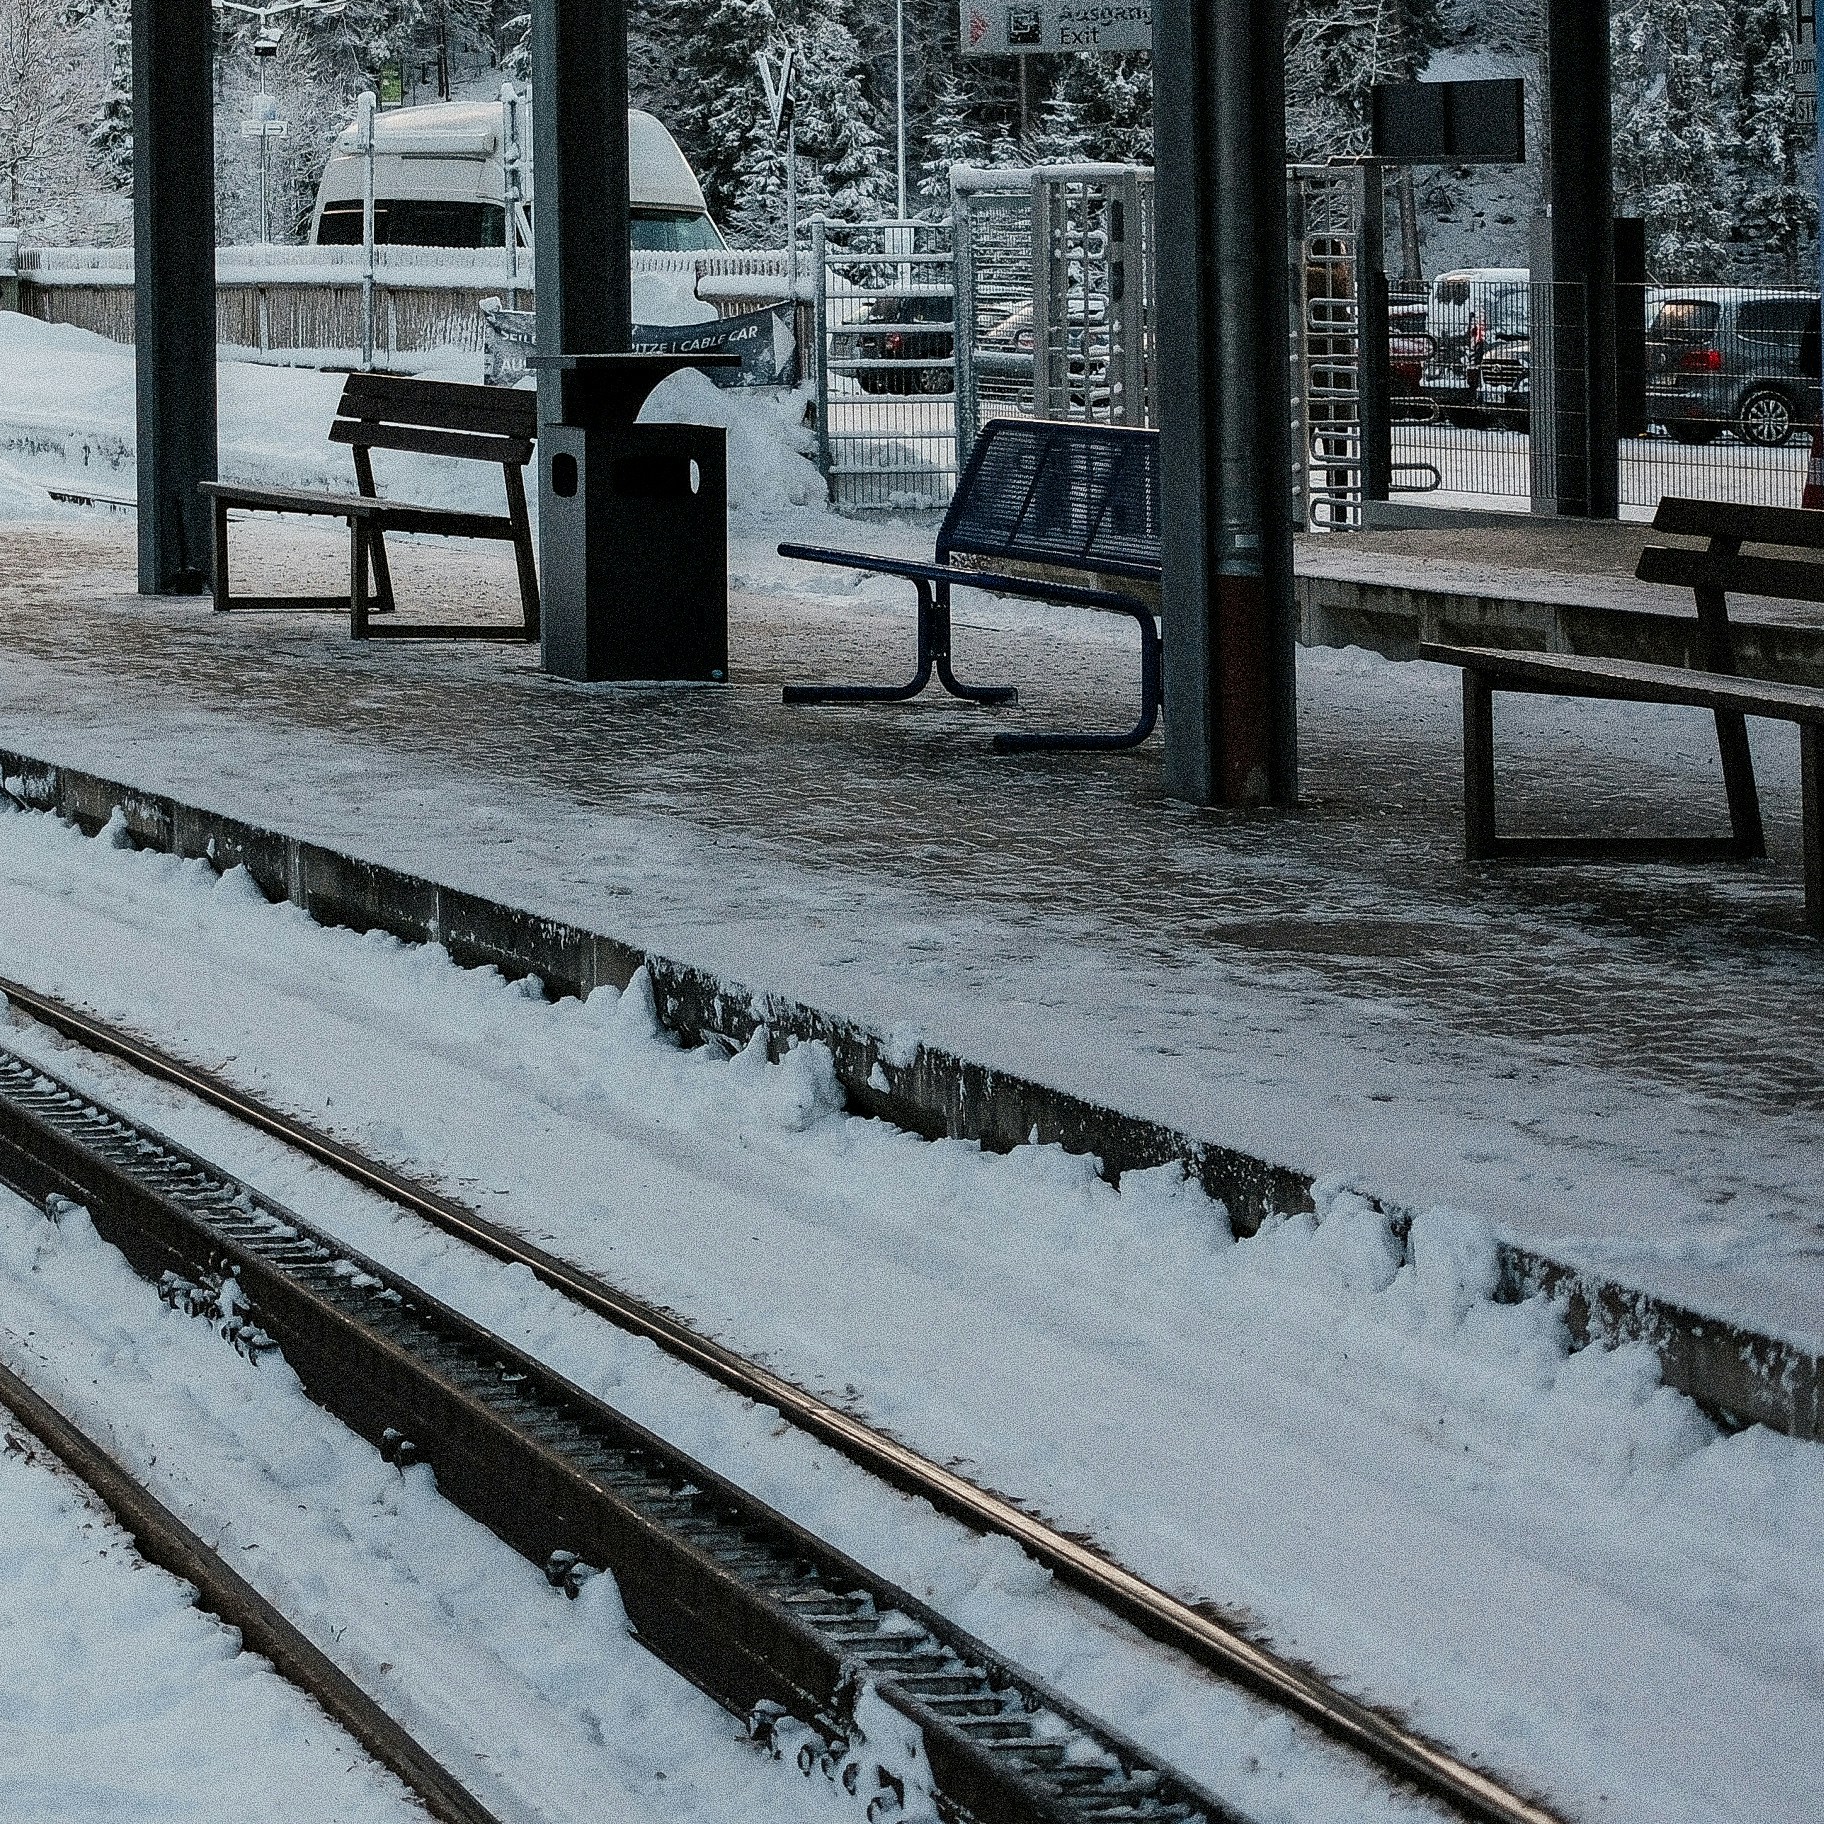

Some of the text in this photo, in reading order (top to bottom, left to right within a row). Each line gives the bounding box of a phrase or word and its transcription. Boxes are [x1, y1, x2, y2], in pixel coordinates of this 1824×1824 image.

[1061, 28, 1100, 45] Exit
[681, 334, 726, 352] CABLE
[728, 325, 758, 342] CAR
